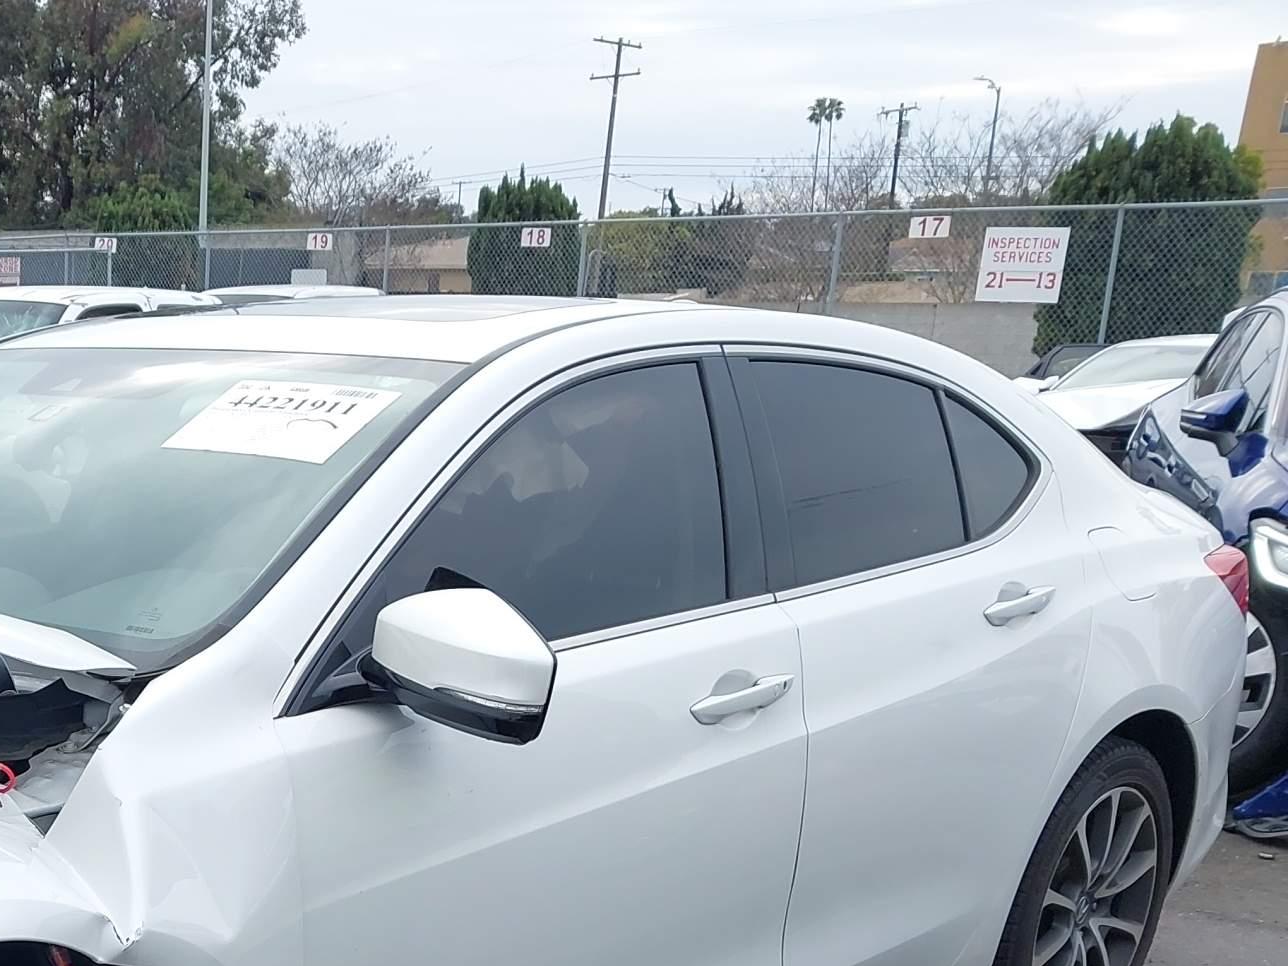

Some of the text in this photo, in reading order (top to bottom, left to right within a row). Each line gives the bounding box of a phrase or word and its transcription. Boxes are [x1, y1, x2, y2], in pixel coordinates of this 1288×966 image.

[918, 217, 945, 236] 17
[312, 234, 328, 248] 19
[527, 229, 546, 245] 18
[987, 237, 1061, 249] INSPECTION
[99, 239, 114, 250] 20
[992, 251, 1052, 263] SERVICES
[229, 394, 358, 415] 44221911
